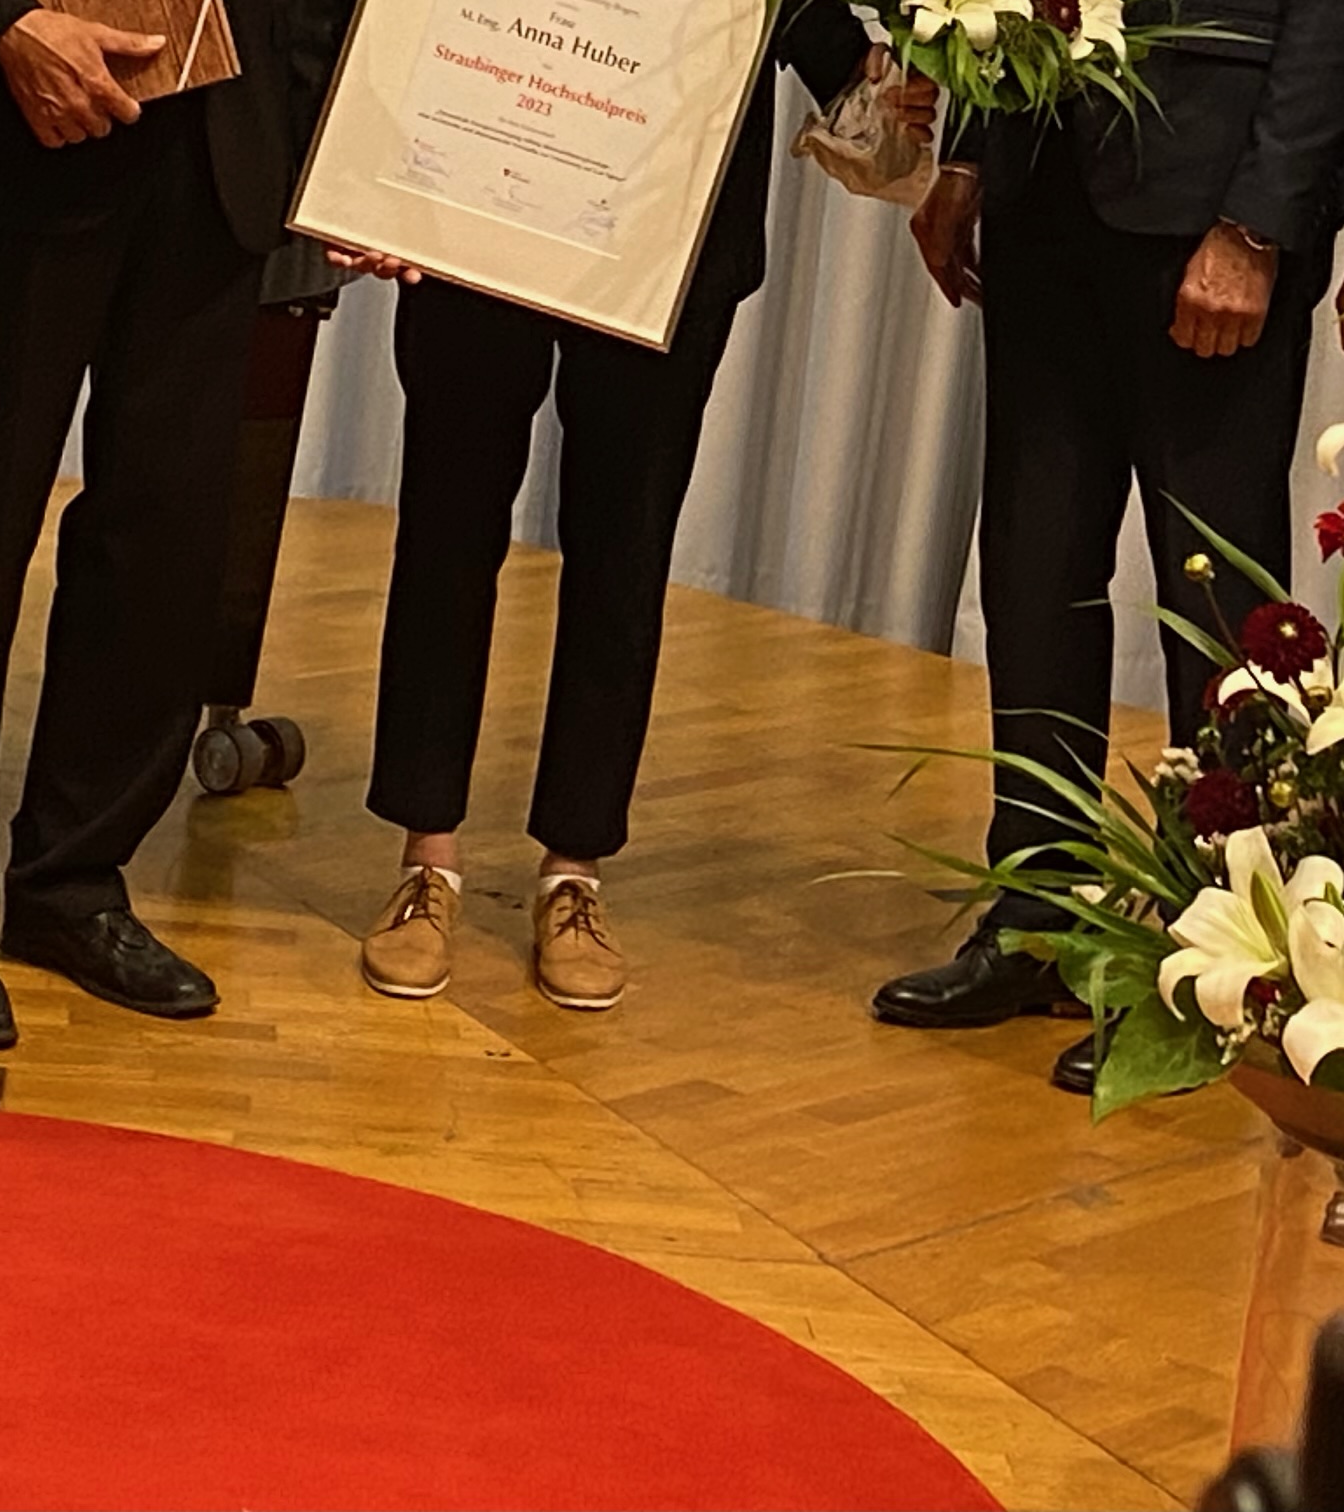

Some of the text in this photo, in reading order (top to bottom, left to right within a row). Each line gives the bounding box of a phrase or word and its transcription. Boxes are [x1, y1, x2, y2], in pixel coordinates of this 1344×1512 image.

[507, 16, 565, 51] Anna
[571, 35, 641, 75] Huber
[433, 42, 648, 126] Straubinger Hochschulpreis
[515, 93, 553, 117] 2023
